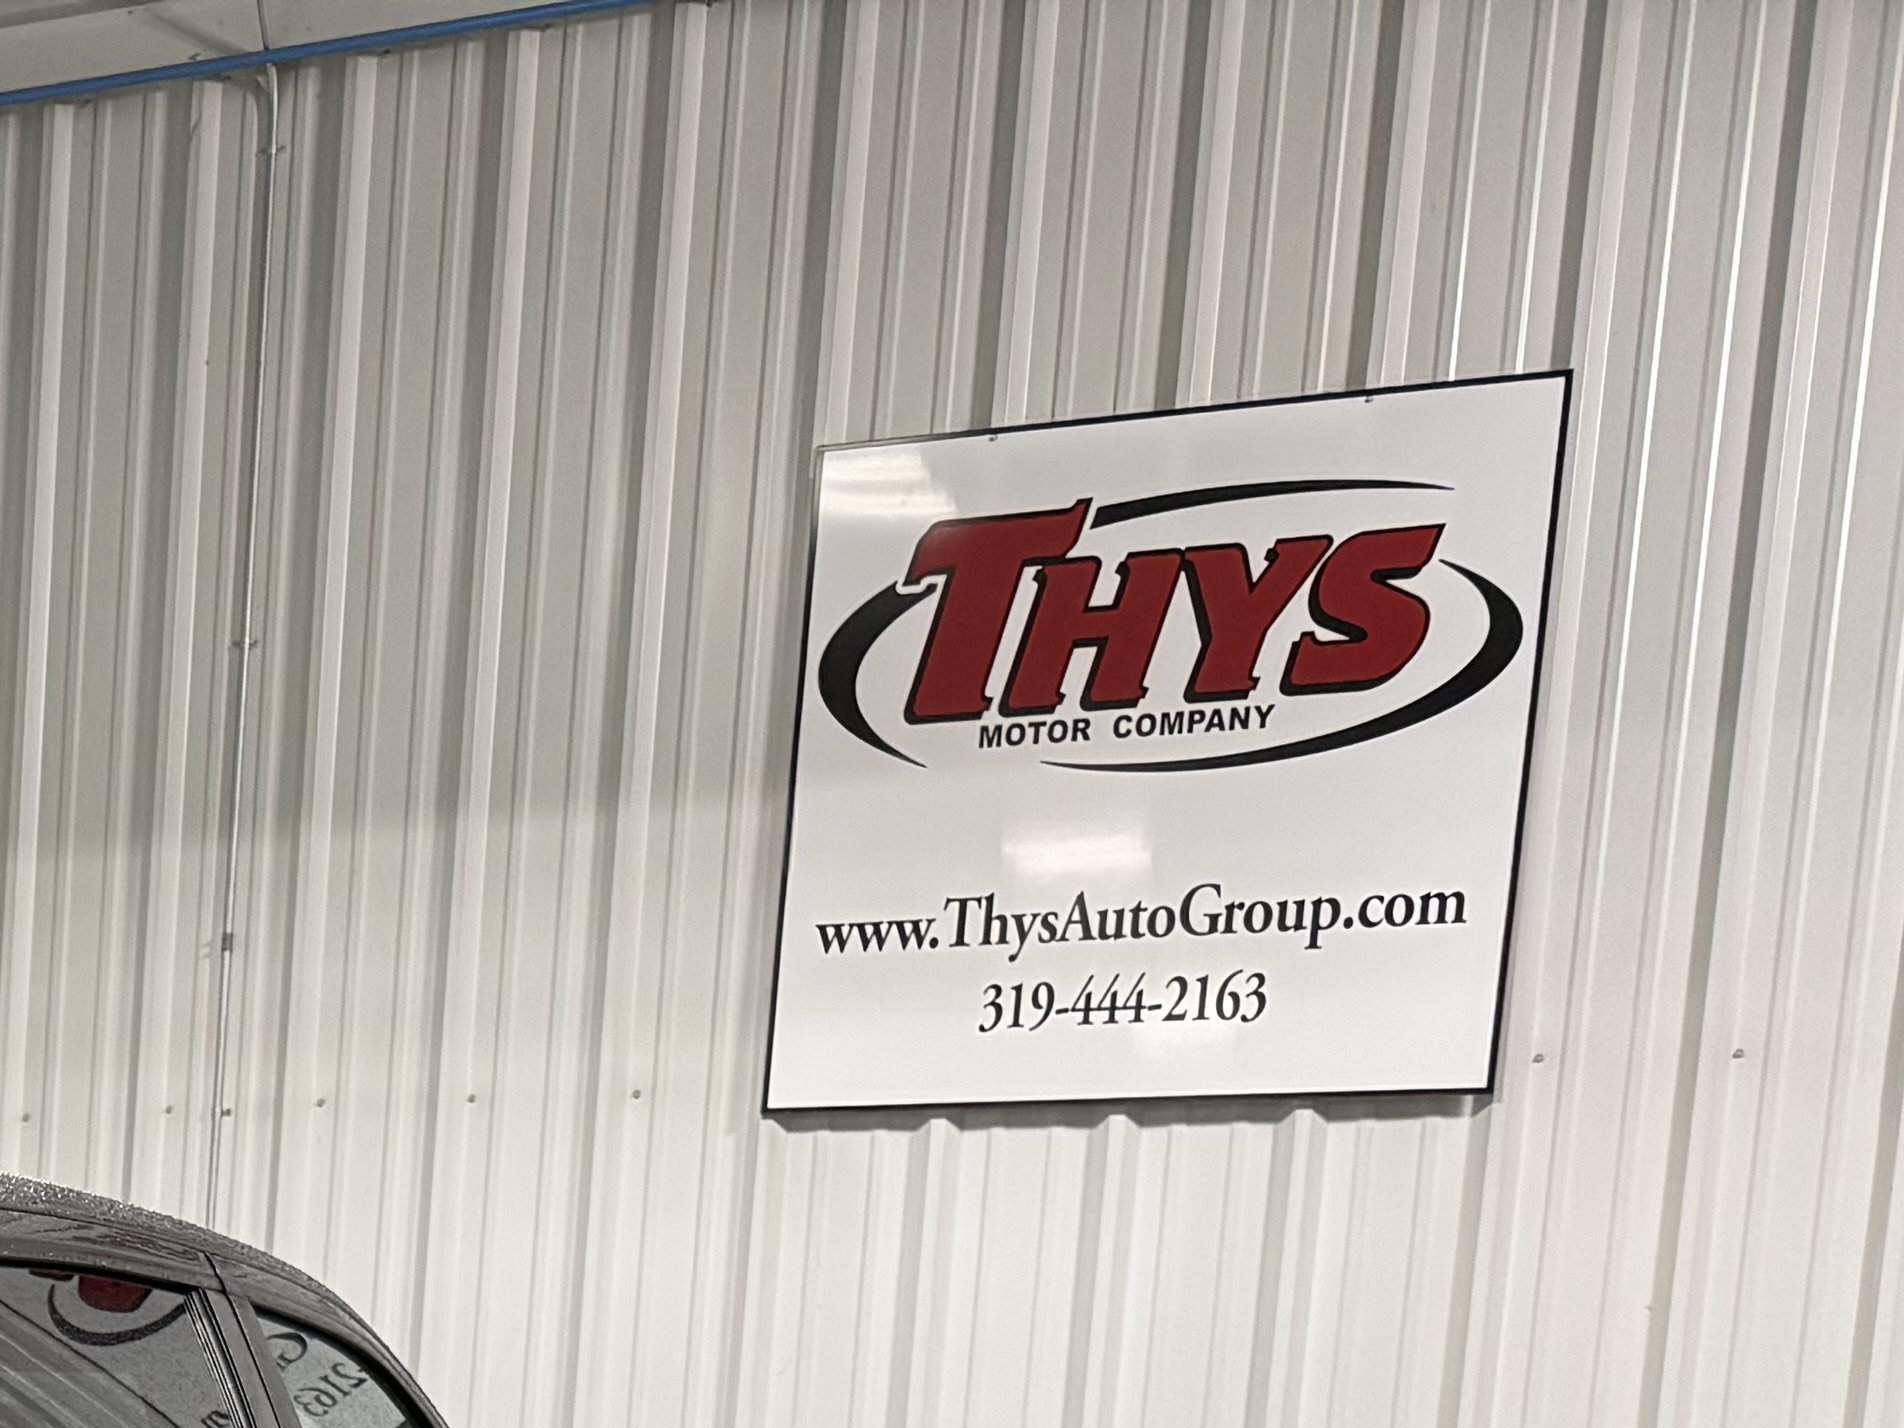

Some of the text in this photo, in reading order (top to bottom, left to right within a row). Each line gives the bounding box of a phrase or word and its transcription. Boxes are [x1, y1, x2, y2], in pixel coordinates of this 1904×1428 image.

[903, 497, 1447, 725] THYS
[979, 703, 1276, 750] MOTOR COMPANY
[815, 883, 1468, 963] www.ThysAutoGroup.com
[978, 970, 1269, 1034] 319-444-2163
